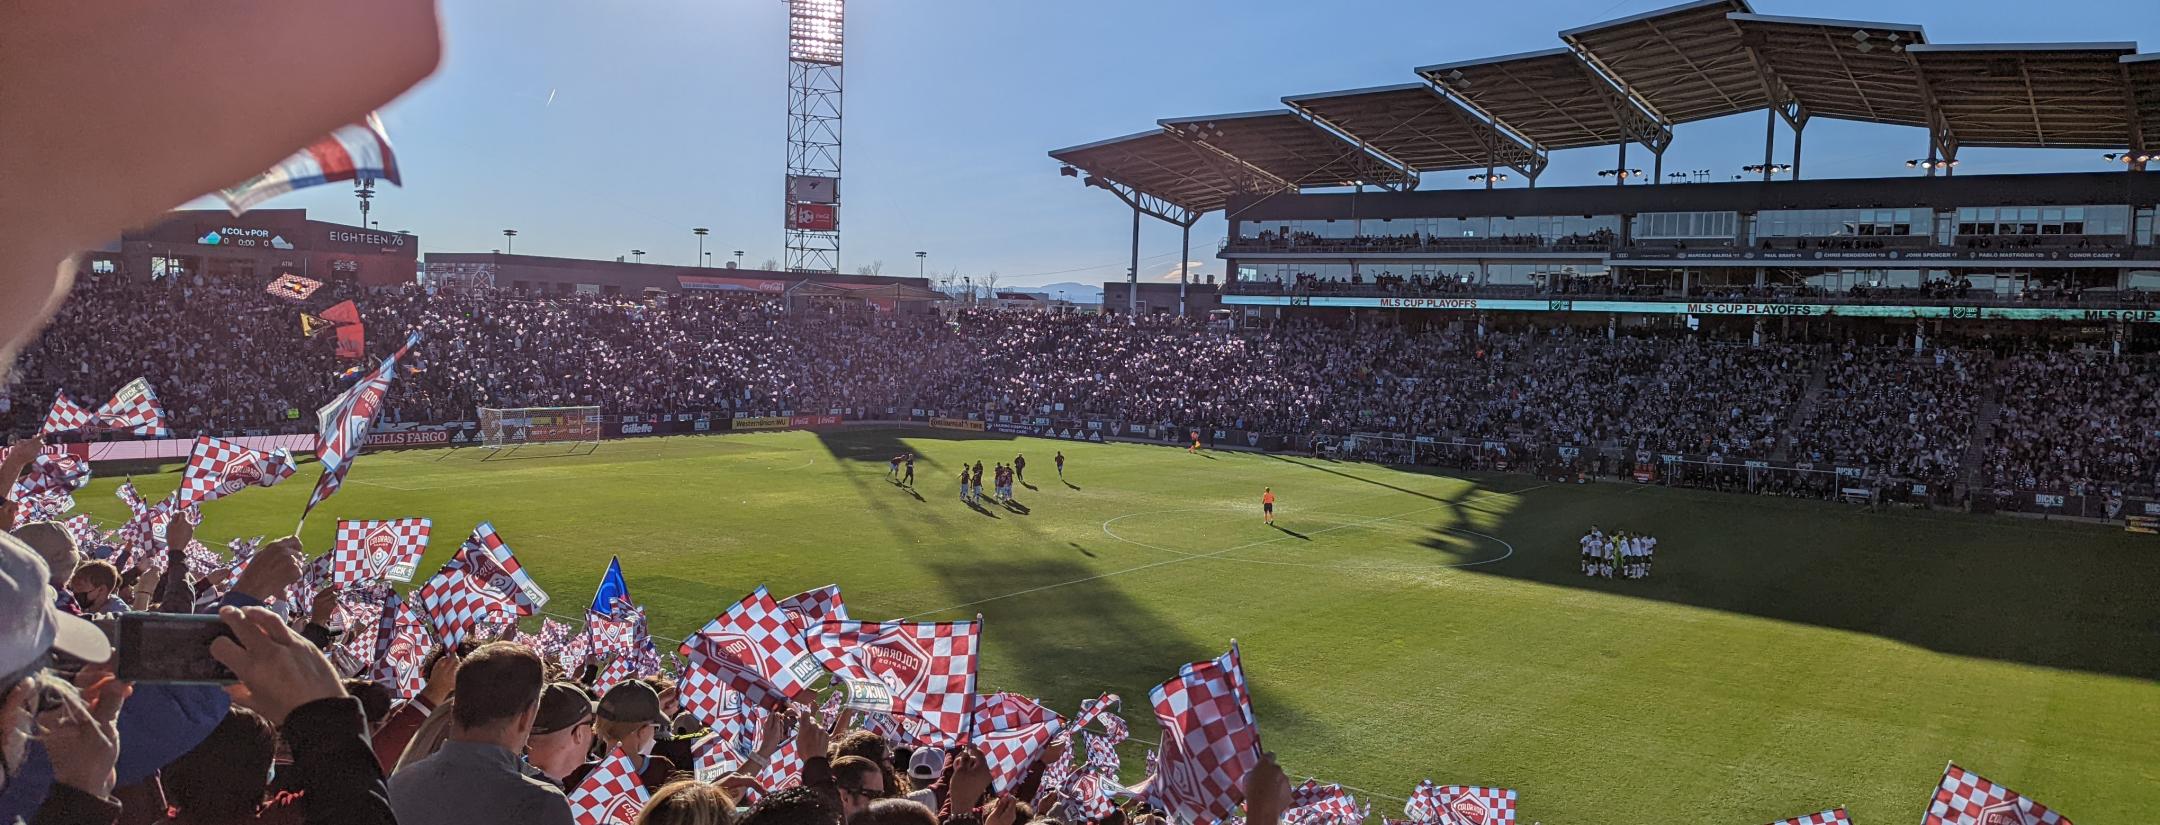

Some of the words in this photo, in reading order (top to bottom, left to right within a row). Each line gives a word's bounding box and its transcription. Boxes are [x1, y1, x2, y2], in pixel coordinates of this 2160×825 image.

[223, 237, 229, 245] 0
[238, 239, 255, 247] 0:00
[263, 240, 269, 248] 0
[329, 231, 390, 245] EIGHTEEN
[391, 234, 404, 247] 76
[1381, 299, 1400, 307] MLS
[1403, 299, 1424, 307] CUP
[1426, 300, 1477, 308] PLAYOFFS
[1687, 303, 1713, 313] MLS
[1716, 304, 1743, 313] CUP
[1746, 304, 1811, 315] PLAYOFFS
[2084, 310, 2118, 321] MLS
[2122, 311, 2156, 322] CUP
[621, 423, 653, 434] Gillette
[365, 433, 405, 444] WELLS
[406, 431, 447, 443] FARGO
[2035, 493, 2064, 504] DICK'S
[1457, 803, 1484, 816] COLORADO
